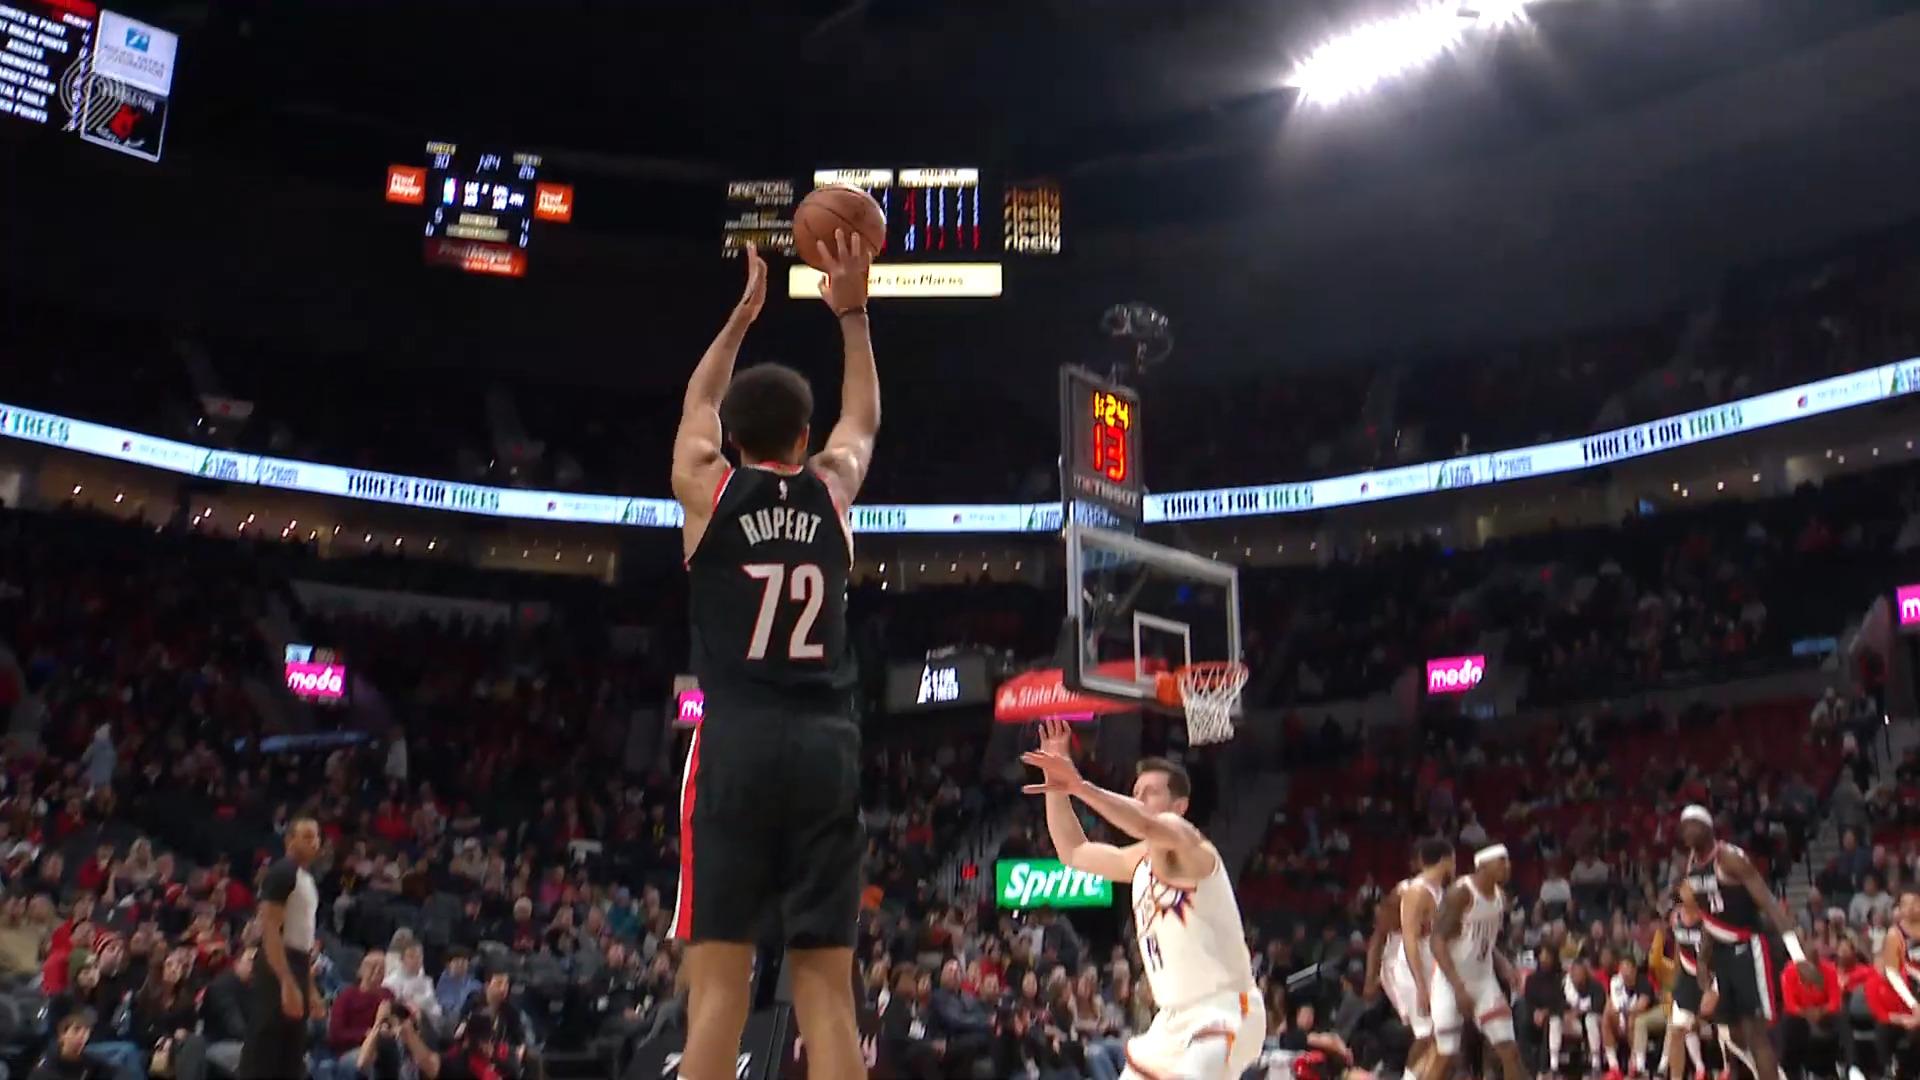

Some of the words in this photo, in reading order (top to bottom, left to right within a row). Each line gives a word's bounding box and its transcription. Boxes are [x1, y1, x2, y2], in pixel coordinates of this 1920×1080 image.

[12, 412, 70, 442] TREES
[1094, 391, 1130, 431] 1:24
[1093, 422, 1126, 482] 13
[1582, 430, 1645, 461] THREES
[1649, 422, 1683, 446] FOR
[1689, 406, 1743, 436] TREES
[347, 473, 409, 499] THREES
[413, 482, 446, 503] FOR
[451, 488, 500, 509] TREES
[1162, 494, 1223, 515] THREES
[1228, 492, 1259, 510] FOR
[1264, 487, 1314, 508] TREES
[739, 507, 822, 547] RUPERT
[741, 563, 824, 660] 72
[287, 667, 342, 692] moda
[1431, 659, 1483, 688] moda
[1004, 863, 1105, 906] Sprite
